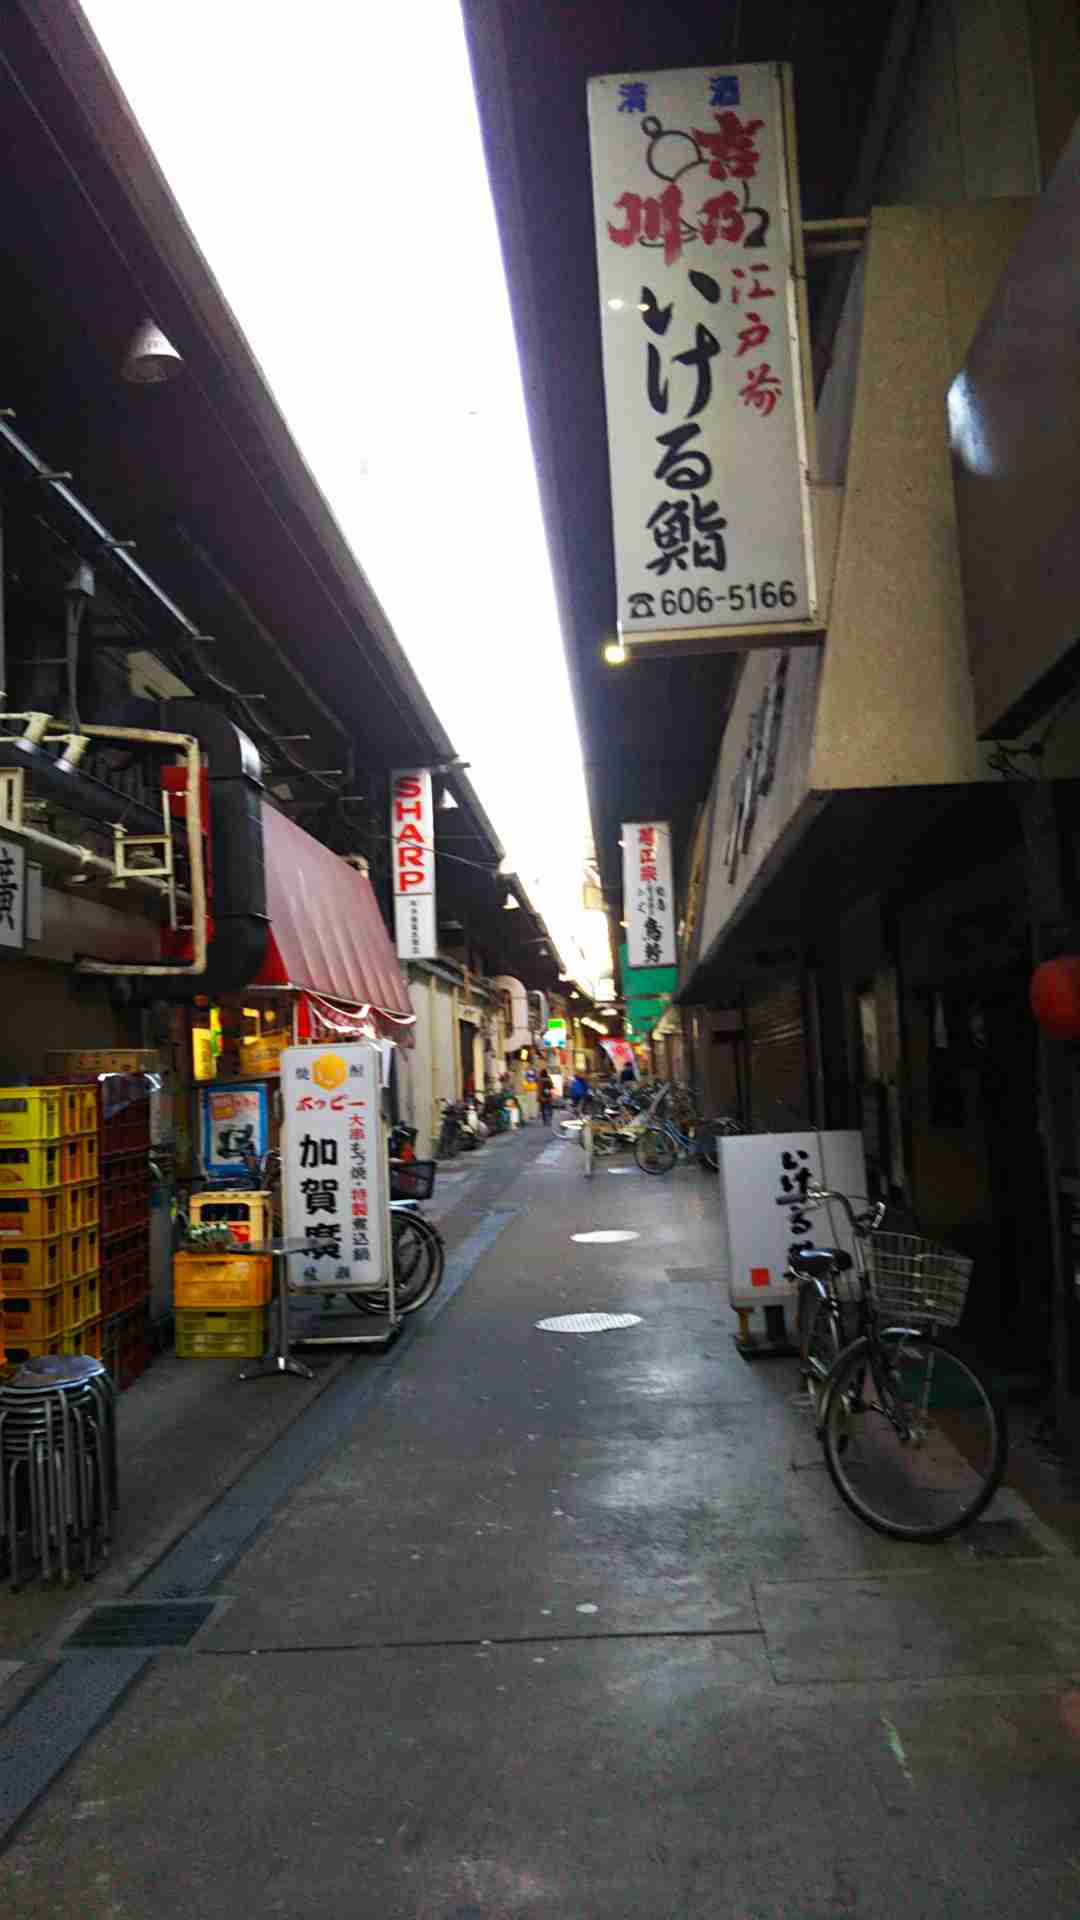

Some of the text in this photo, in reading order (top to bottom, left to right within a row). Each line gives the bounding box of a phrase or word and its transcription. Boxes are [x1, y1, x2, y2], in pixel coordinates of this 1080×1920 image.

[731, 263, 783, 417] 江戸前
[641, 269, 728, 576] いける鮨
[660, 580, 797, 617] 606-5166
[394, 776, 425, 892] SHARP
[296, 1093, 367, 1112] ホッピー
[299, 1133, 342, 1260] 加賀廣
